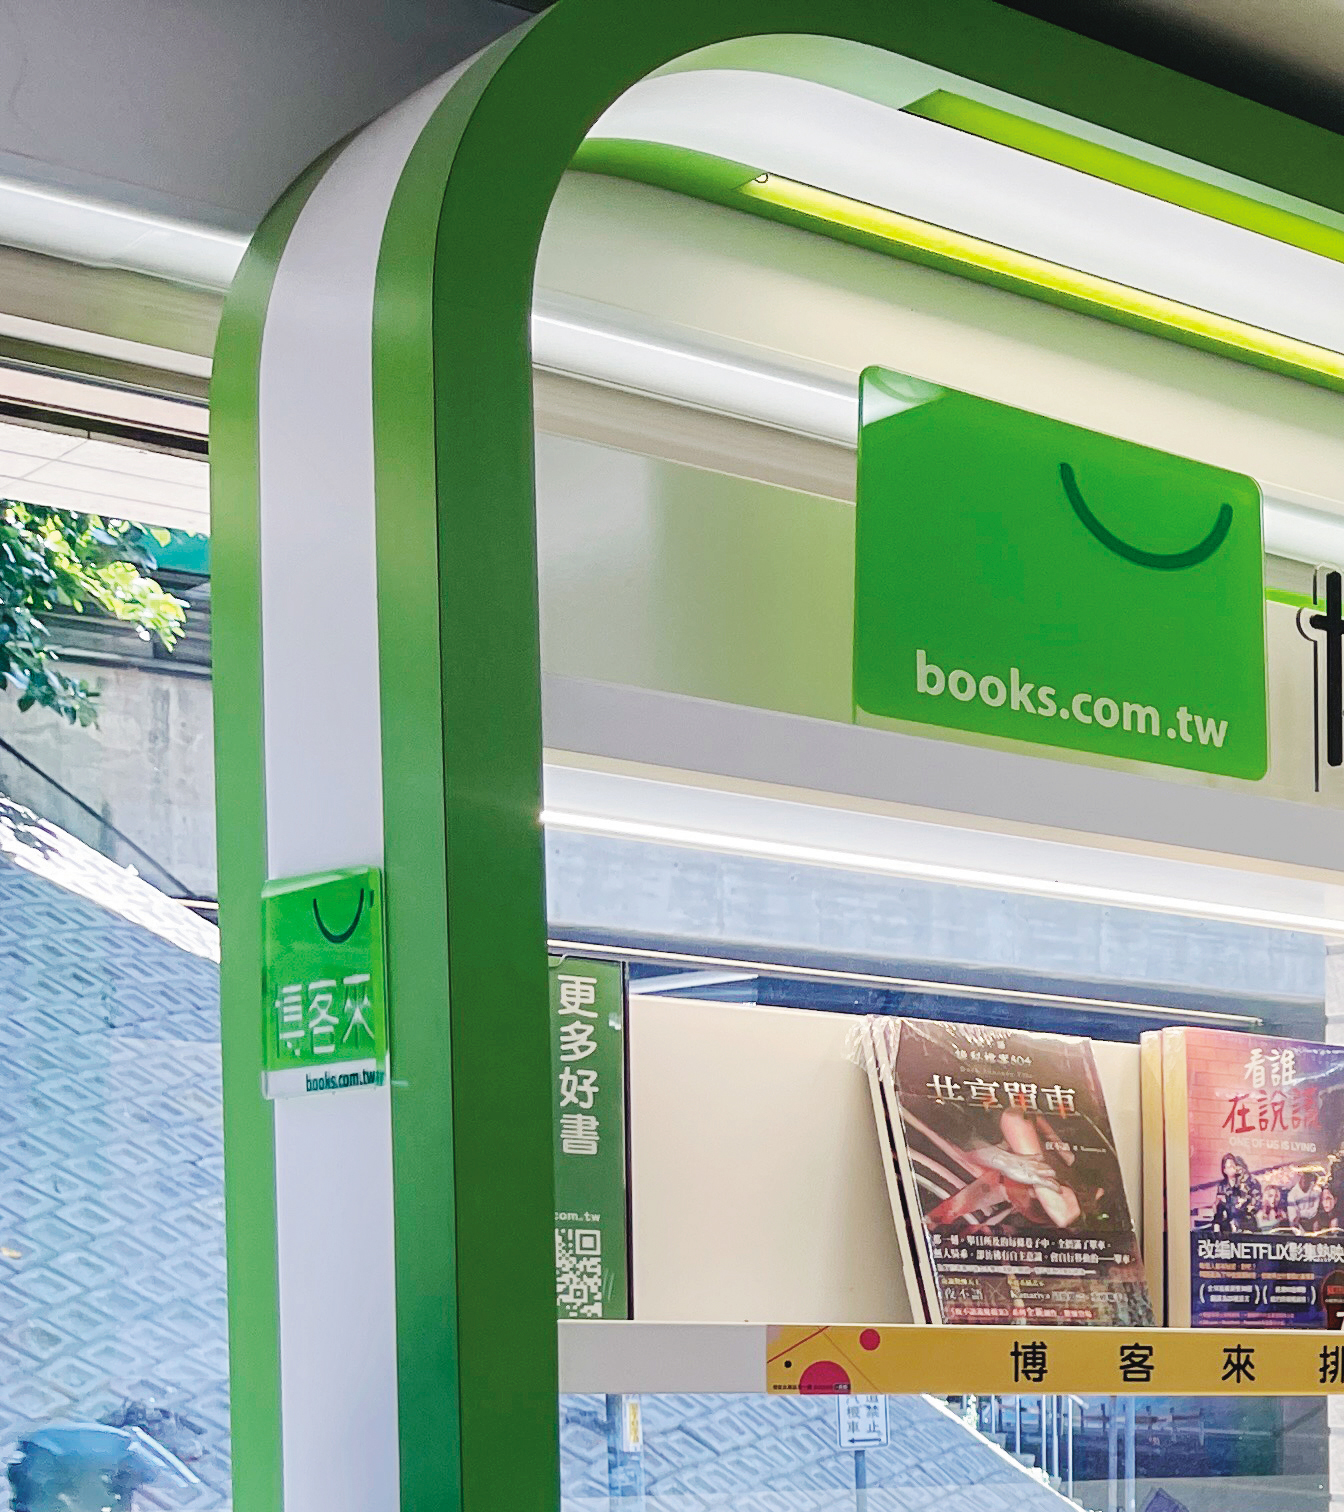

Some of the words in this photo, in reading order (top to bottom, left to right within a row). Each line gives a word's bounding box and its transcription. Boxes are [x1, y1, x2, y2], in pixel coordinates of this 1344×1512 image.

[915, 651, 1228, 749] books.com.tw
[305, 1071, 378, 1092] books.com.tw
[557, 974, 600, 1155] 更多好書
[1244, 1048, 1297, 1088] 看誰
[1229, 1137, 1250, 1147] ONE
[1252, 1139, 1265, 1148] OF
[1266, 1140, 1280, 1149] US
[1290, 1142, 1317, 1153] LYING
